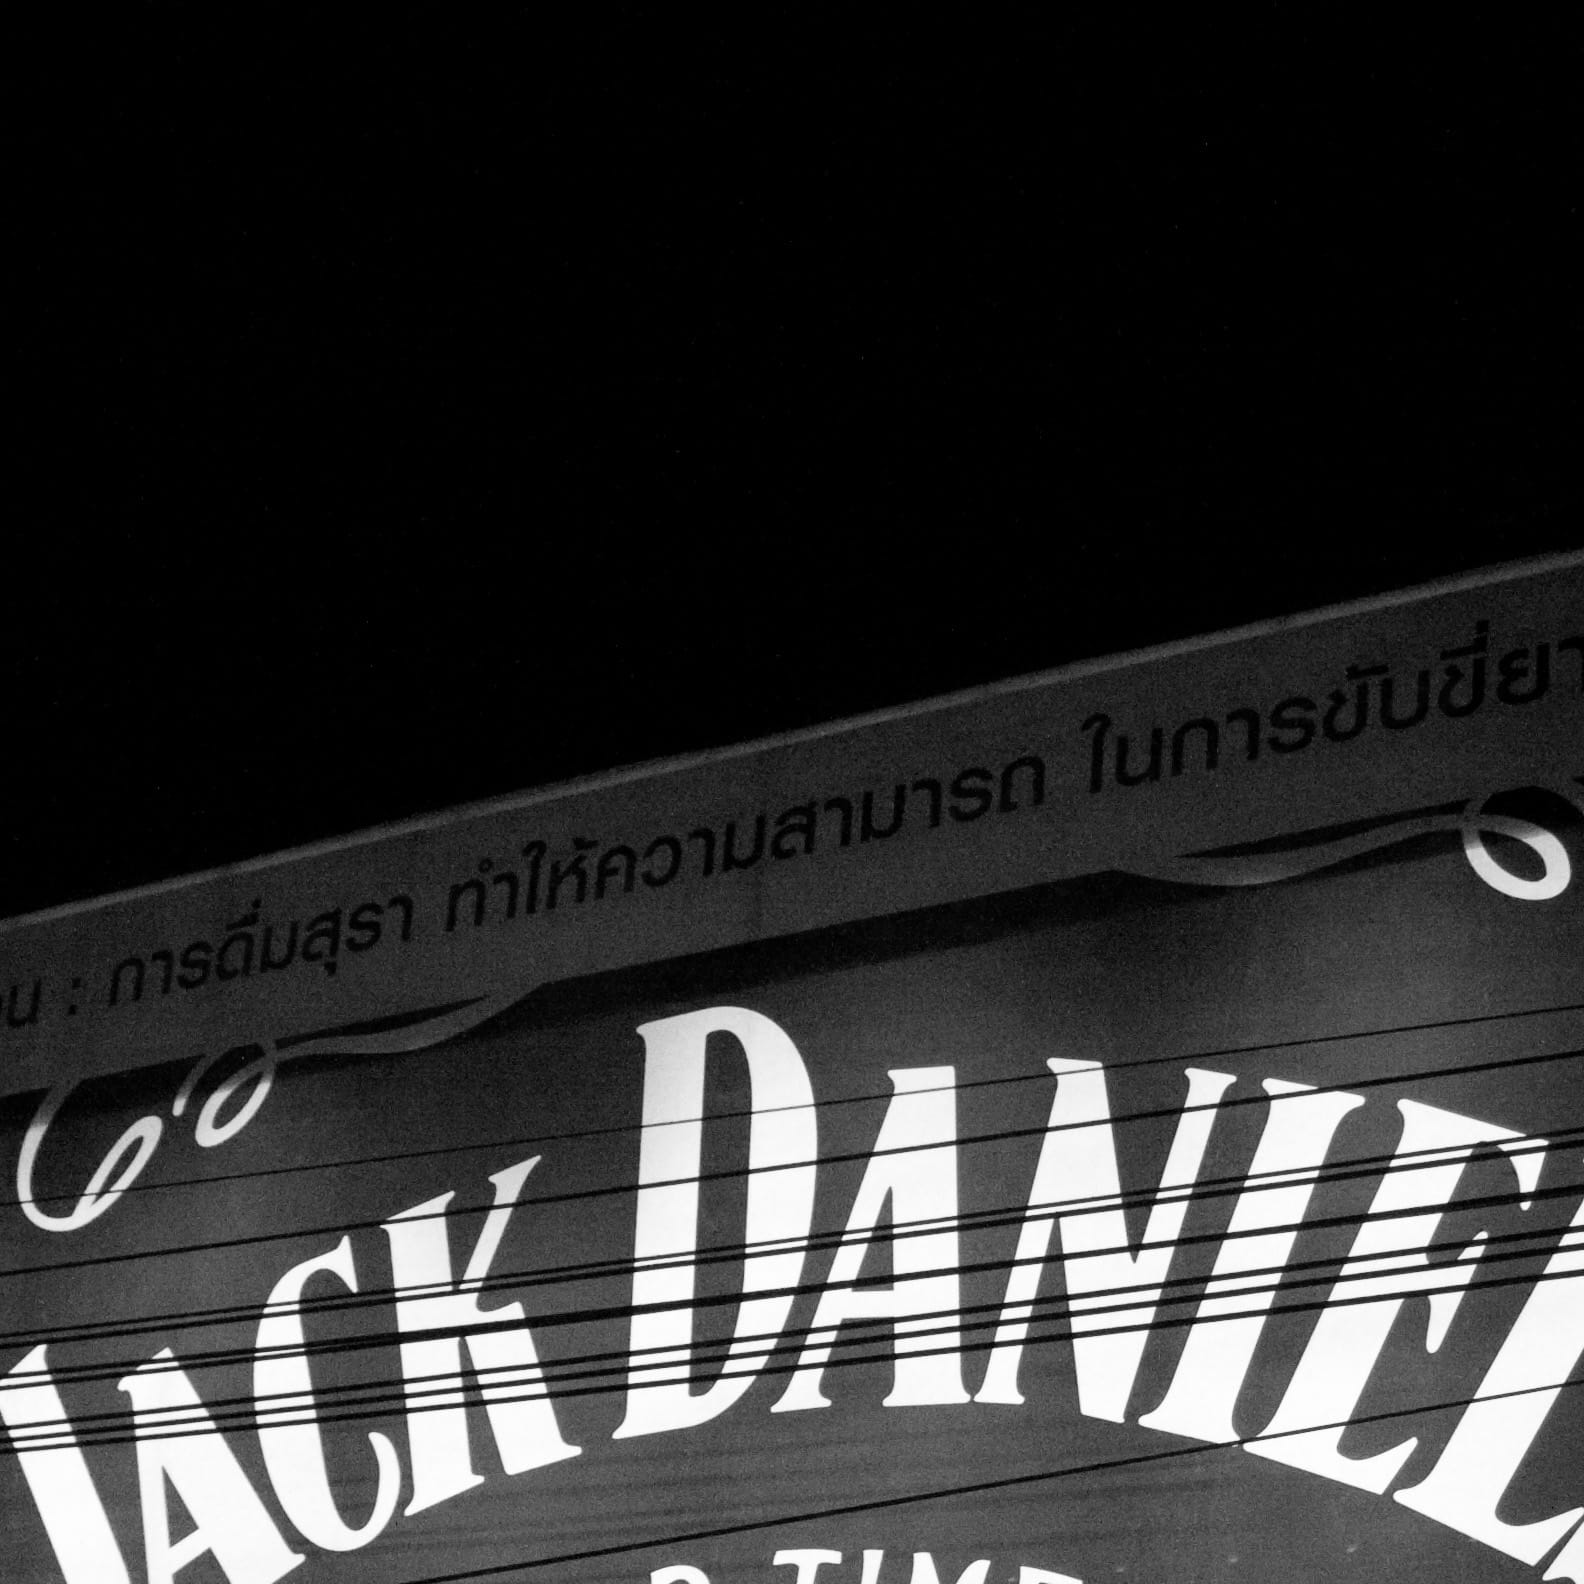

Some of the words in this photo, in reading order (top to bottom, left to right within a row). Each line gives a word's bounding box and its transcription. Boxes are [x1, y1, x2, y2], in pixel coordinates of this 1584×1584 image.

[111, 890, 415, 1010] การดื่มสุรา
[445, 752, 1045, 934] ทำให้ความสามารถ
